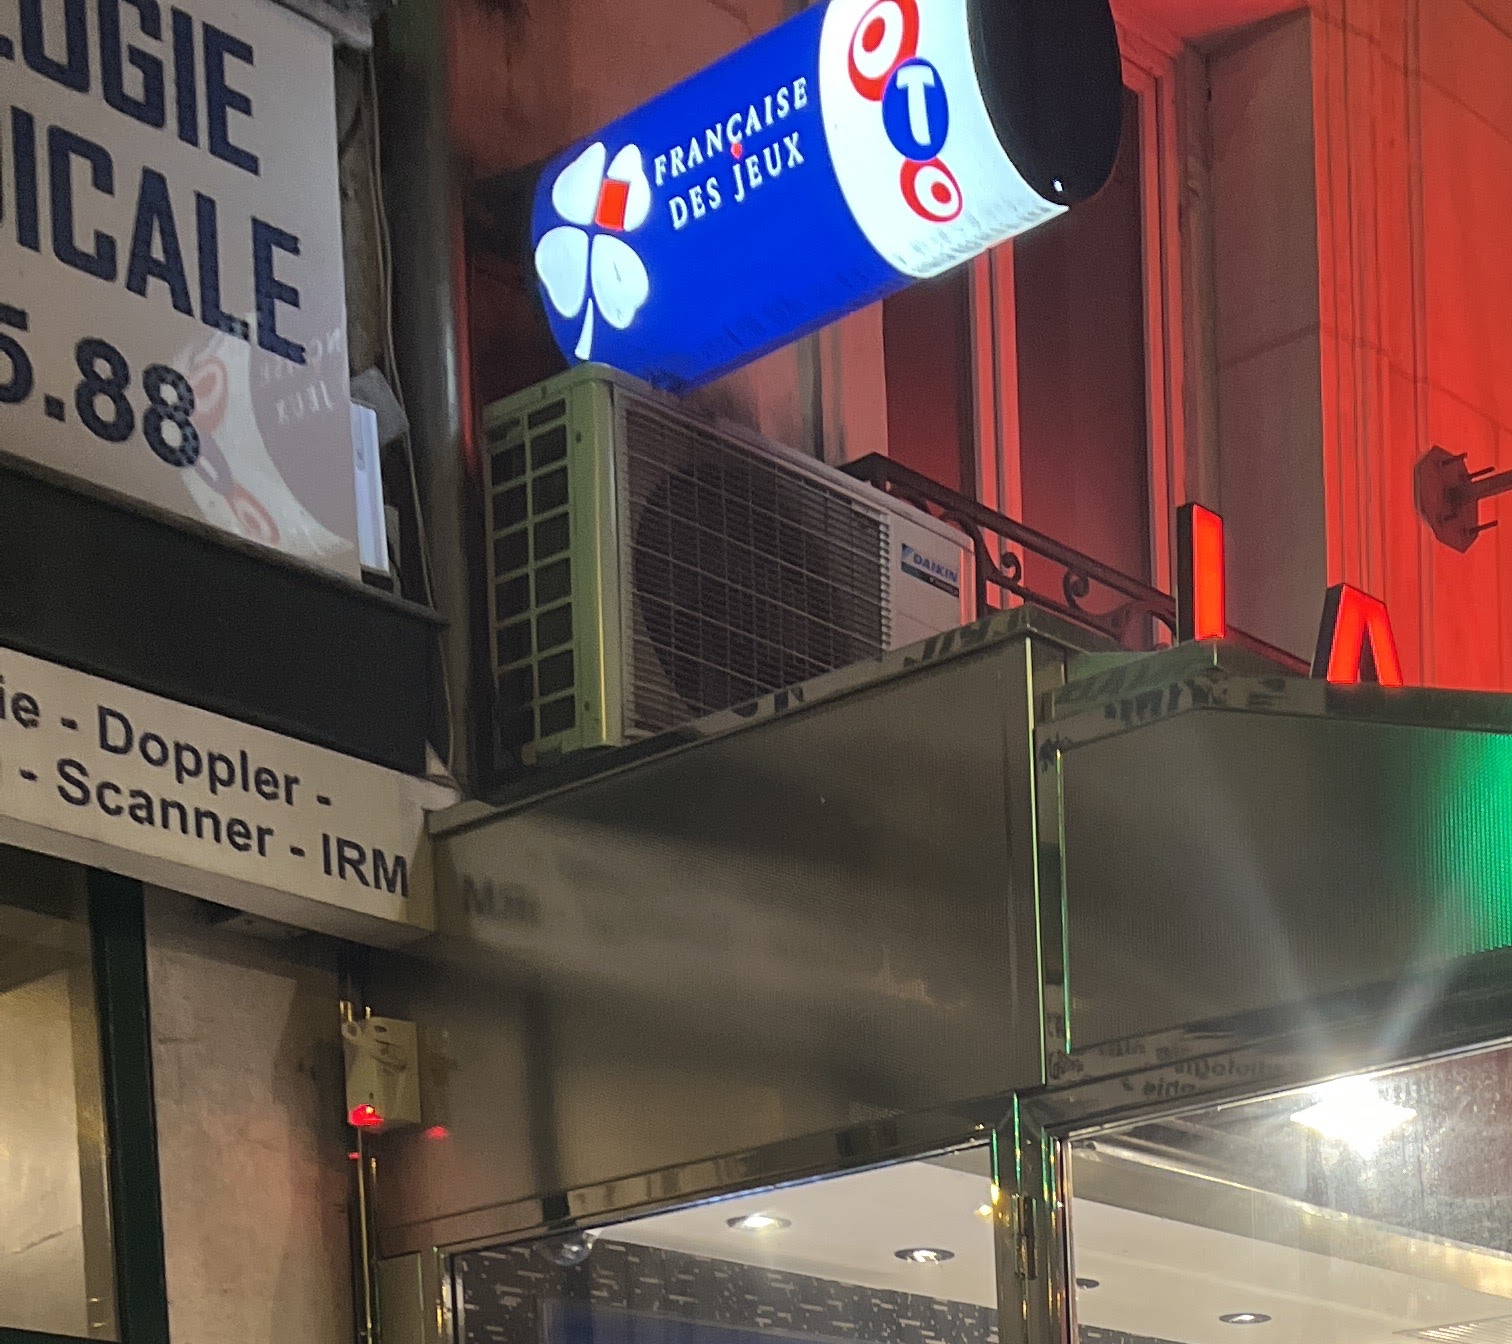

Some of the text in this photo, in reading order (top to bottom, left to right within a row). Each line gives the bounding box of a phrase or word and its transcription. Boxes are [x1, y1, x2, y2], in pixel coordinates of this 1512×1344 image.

[0, 0, 260, 176] OGIE
[653, 76, 809, 187] FRANÇAISE
[0, 105, 307, 365] ICALE
[668, 132, 805, 230] DES JEUX
[914, 553, 958, 583] DAIKIN
[97, 705, 300, 805] Doppler
[57, 757, 274, 857] Scanner
[322, 832, 409, 897] IRM
